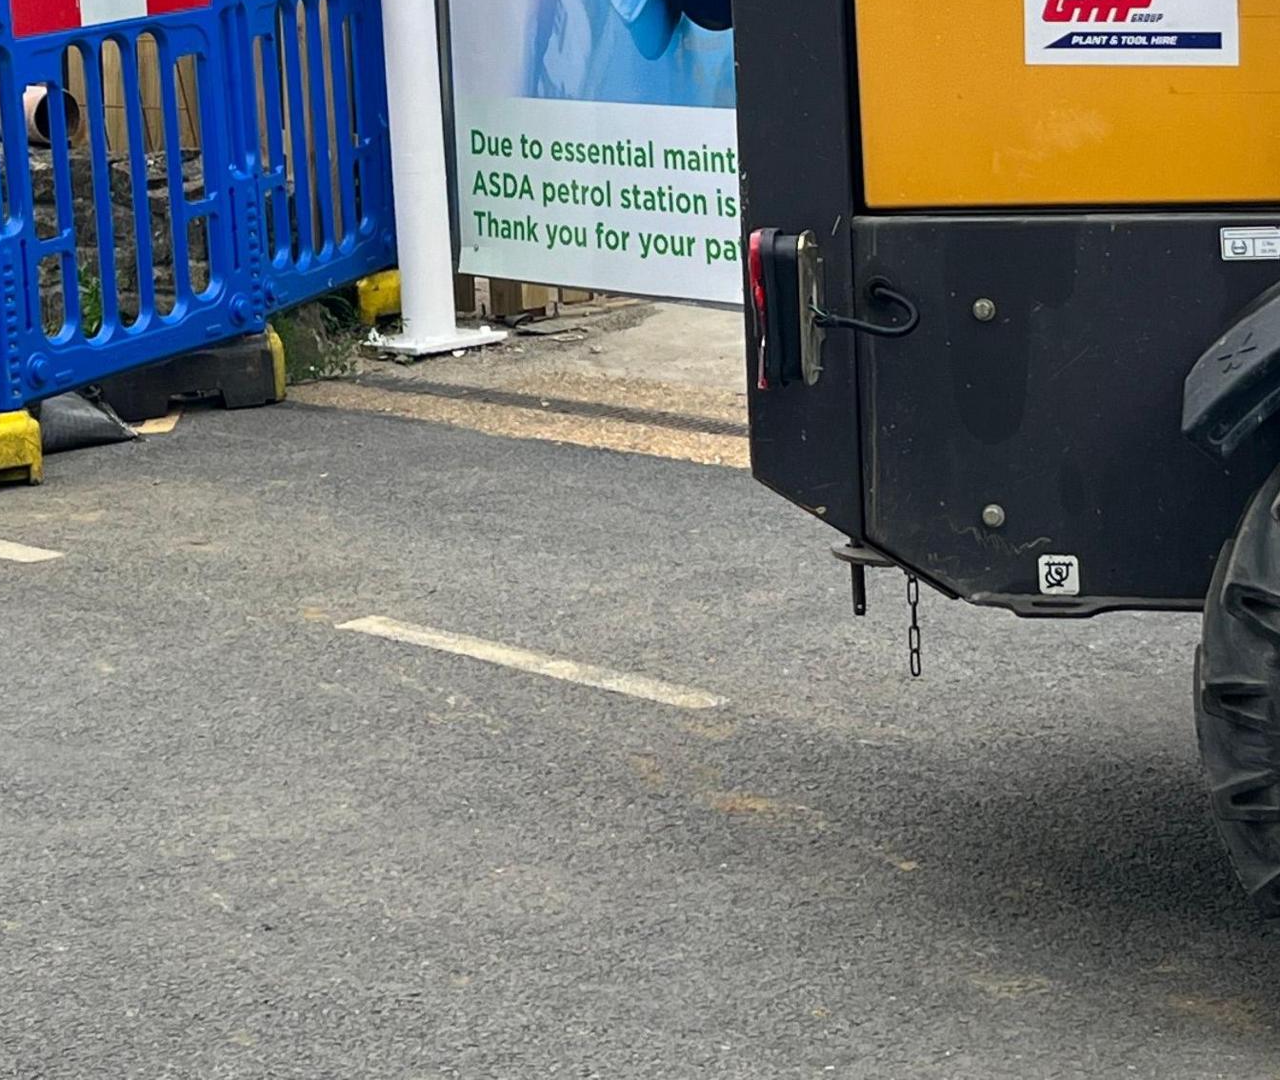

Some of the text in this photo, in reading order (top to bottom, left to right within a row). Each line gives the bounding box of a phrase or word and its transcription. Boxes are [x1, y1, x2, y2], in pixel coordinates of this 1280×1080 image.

[1131, 13, 1164, 23] GROUP
[1072, 35, 1178, 46] PLANT & TOOL HIRE
[471, 130, 736, 174] Due to essential maint
[472, 170, 736, 218] ASDA petrol station is
[474, 210, 739, 265] Thank you for your pa
